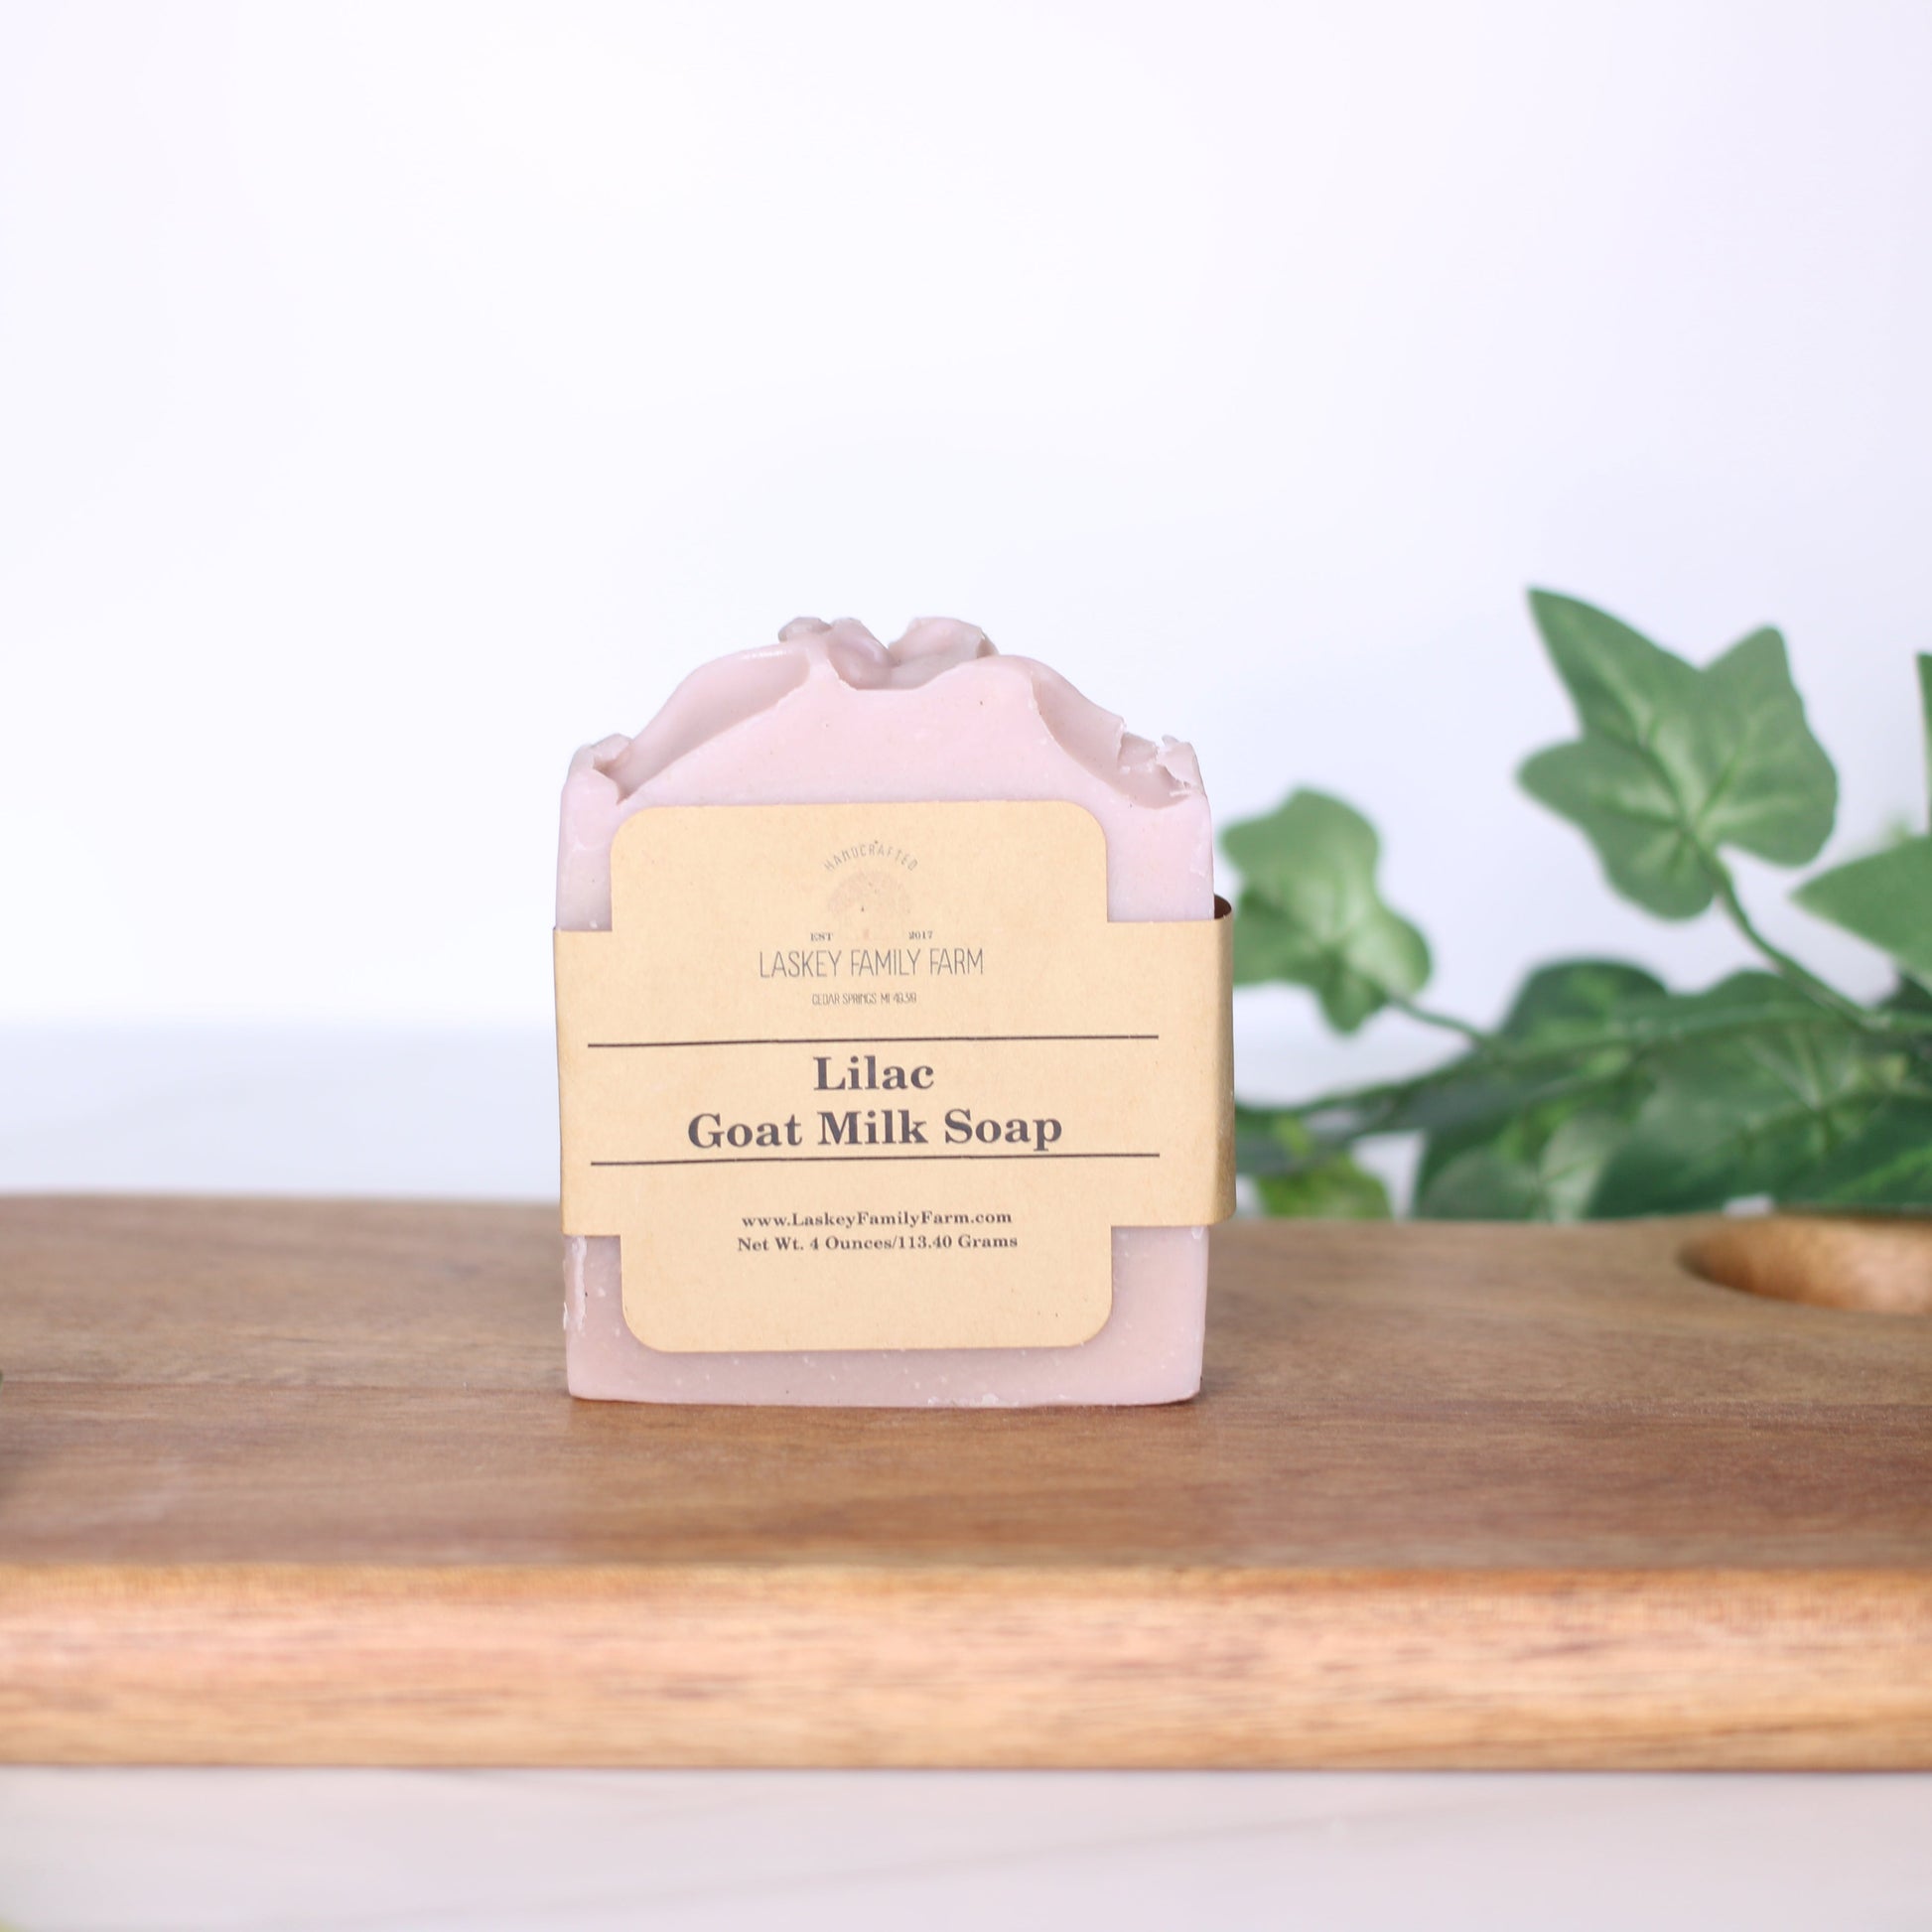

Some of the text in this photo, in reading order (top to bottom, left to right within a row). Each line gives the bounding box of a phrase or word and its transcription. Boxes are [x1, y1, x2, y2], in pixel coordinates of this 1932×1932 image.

[823, 843, 918, 872] HANDCRAFTED
[809, 930, 933, 942] EST 2017
[759, 947, 984, 979] LASKEY FAMILY FARM
[811, 992, 840, 1006] CEDAR
[842, 992, 877, 1005] SPRINGS
[813, 1054, 935, 1091] Lilac
[687, 1108, 1063, 1152] Goat Milk Soap
[741, 1209, 1013, 1229] www.LaskeyFamilyFarm.com
[737, 1233, 1019, 1252] Net Wt. 4 Ounces/113.40 Grams
